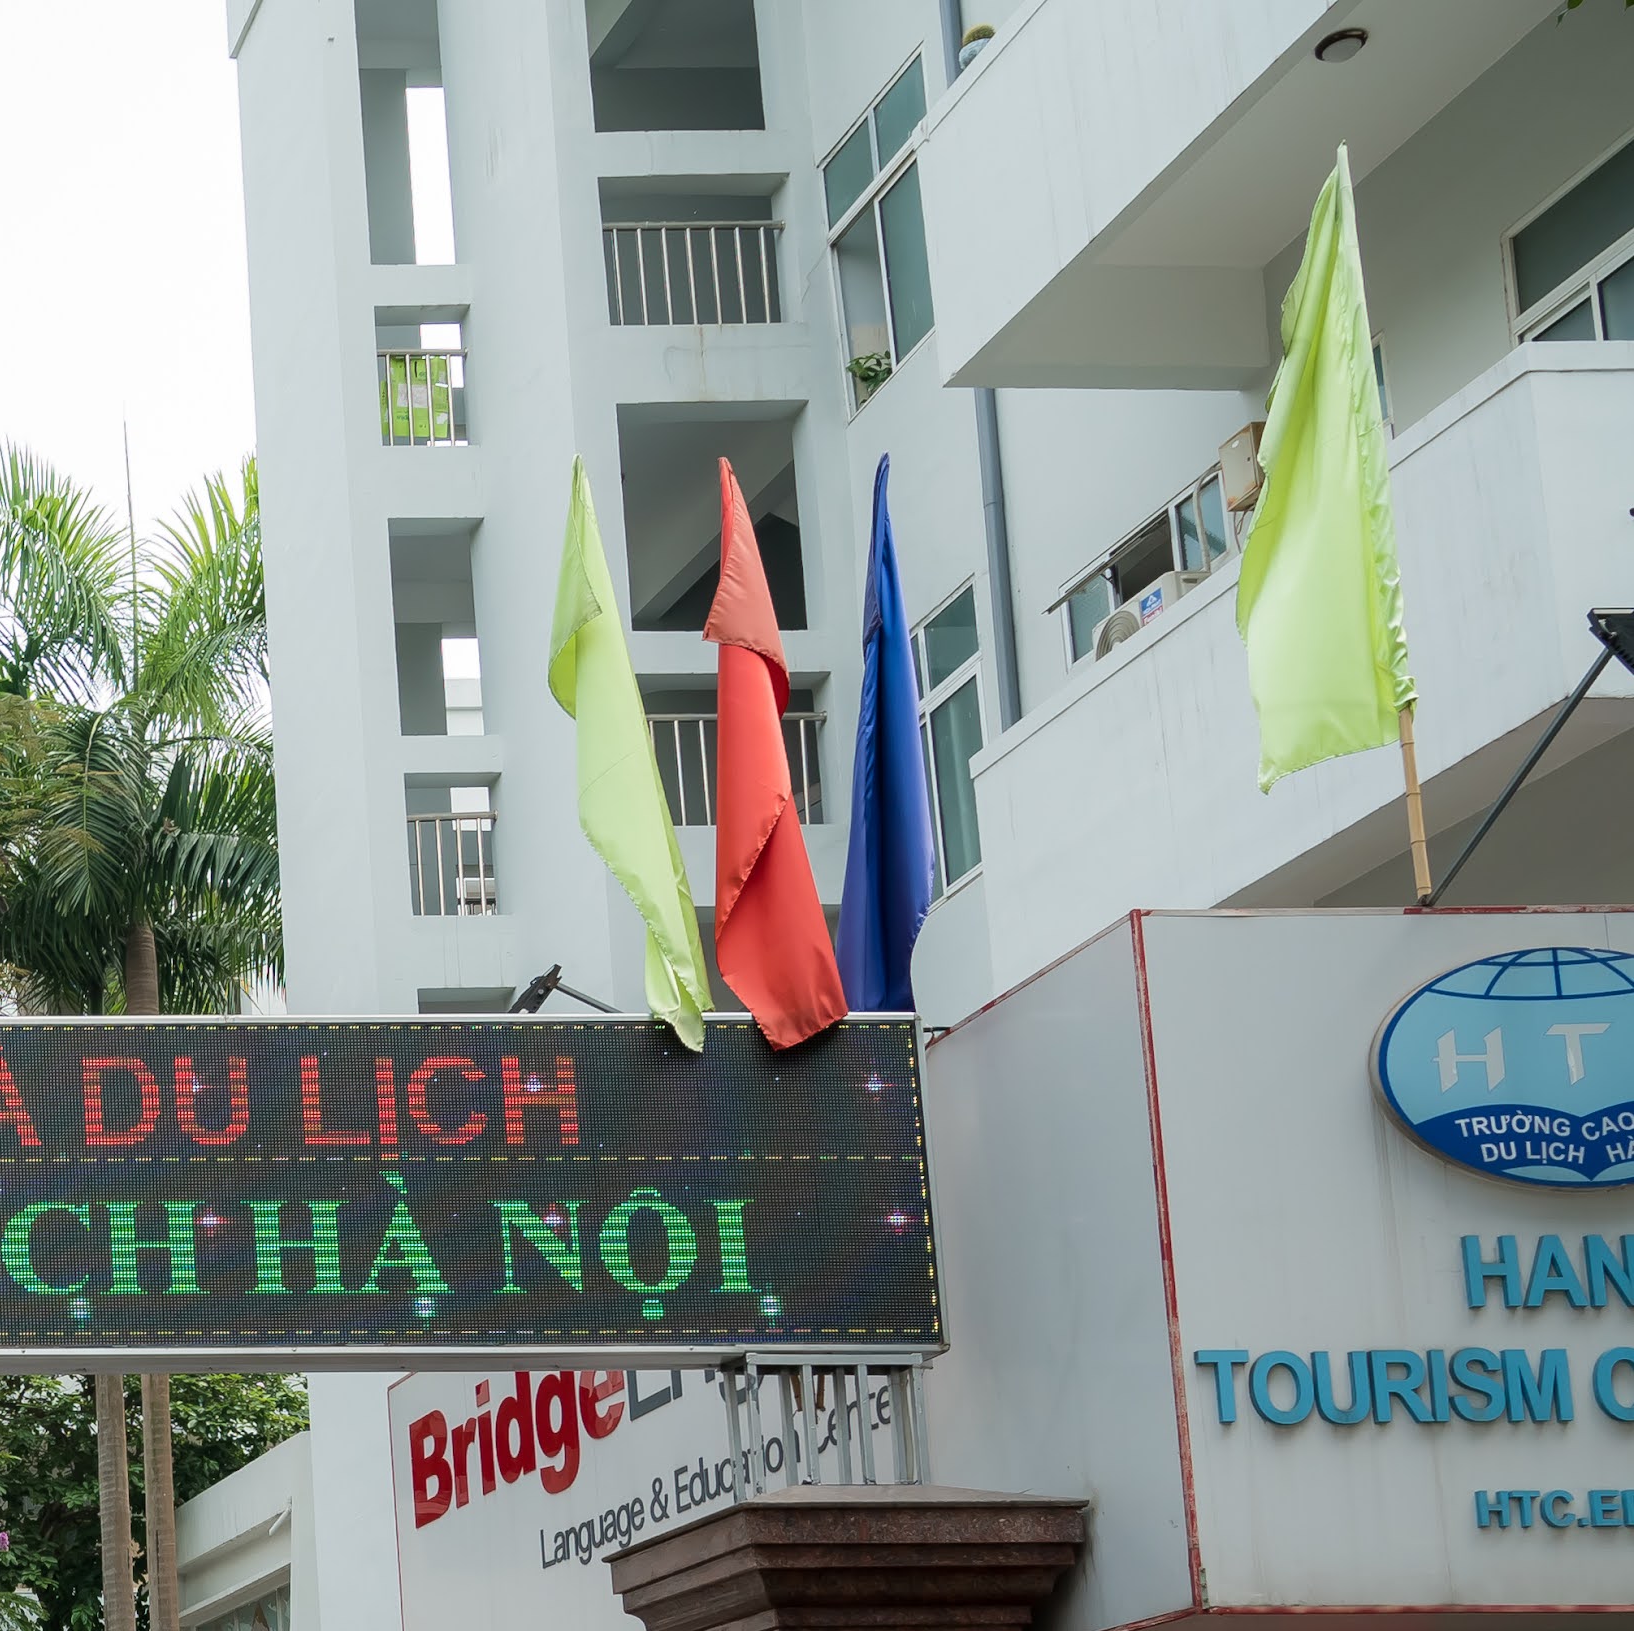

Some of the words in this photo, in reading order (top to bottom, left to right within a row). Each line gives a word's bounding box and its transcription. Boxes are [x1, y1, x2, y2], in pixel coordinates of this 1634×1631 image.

[82, 1055, 249, 1145] DU
[300, 1055, 579, 1160] LỊCH
[1454, 1110, 1572, 1138] TRƯỜNG
[1481, 1141, 1517, 1163] DU
[1526, 1141, 1586, 1164] LỊCH
[247, 1170, 453, 1296] HÀ
[491, 1186, 761, 1320] NỘI
[1194, 1348, 1574, 1425] TOURISM
[540, 1495, 645, 1571] Language
[649, 1477, 670, 1524] &
